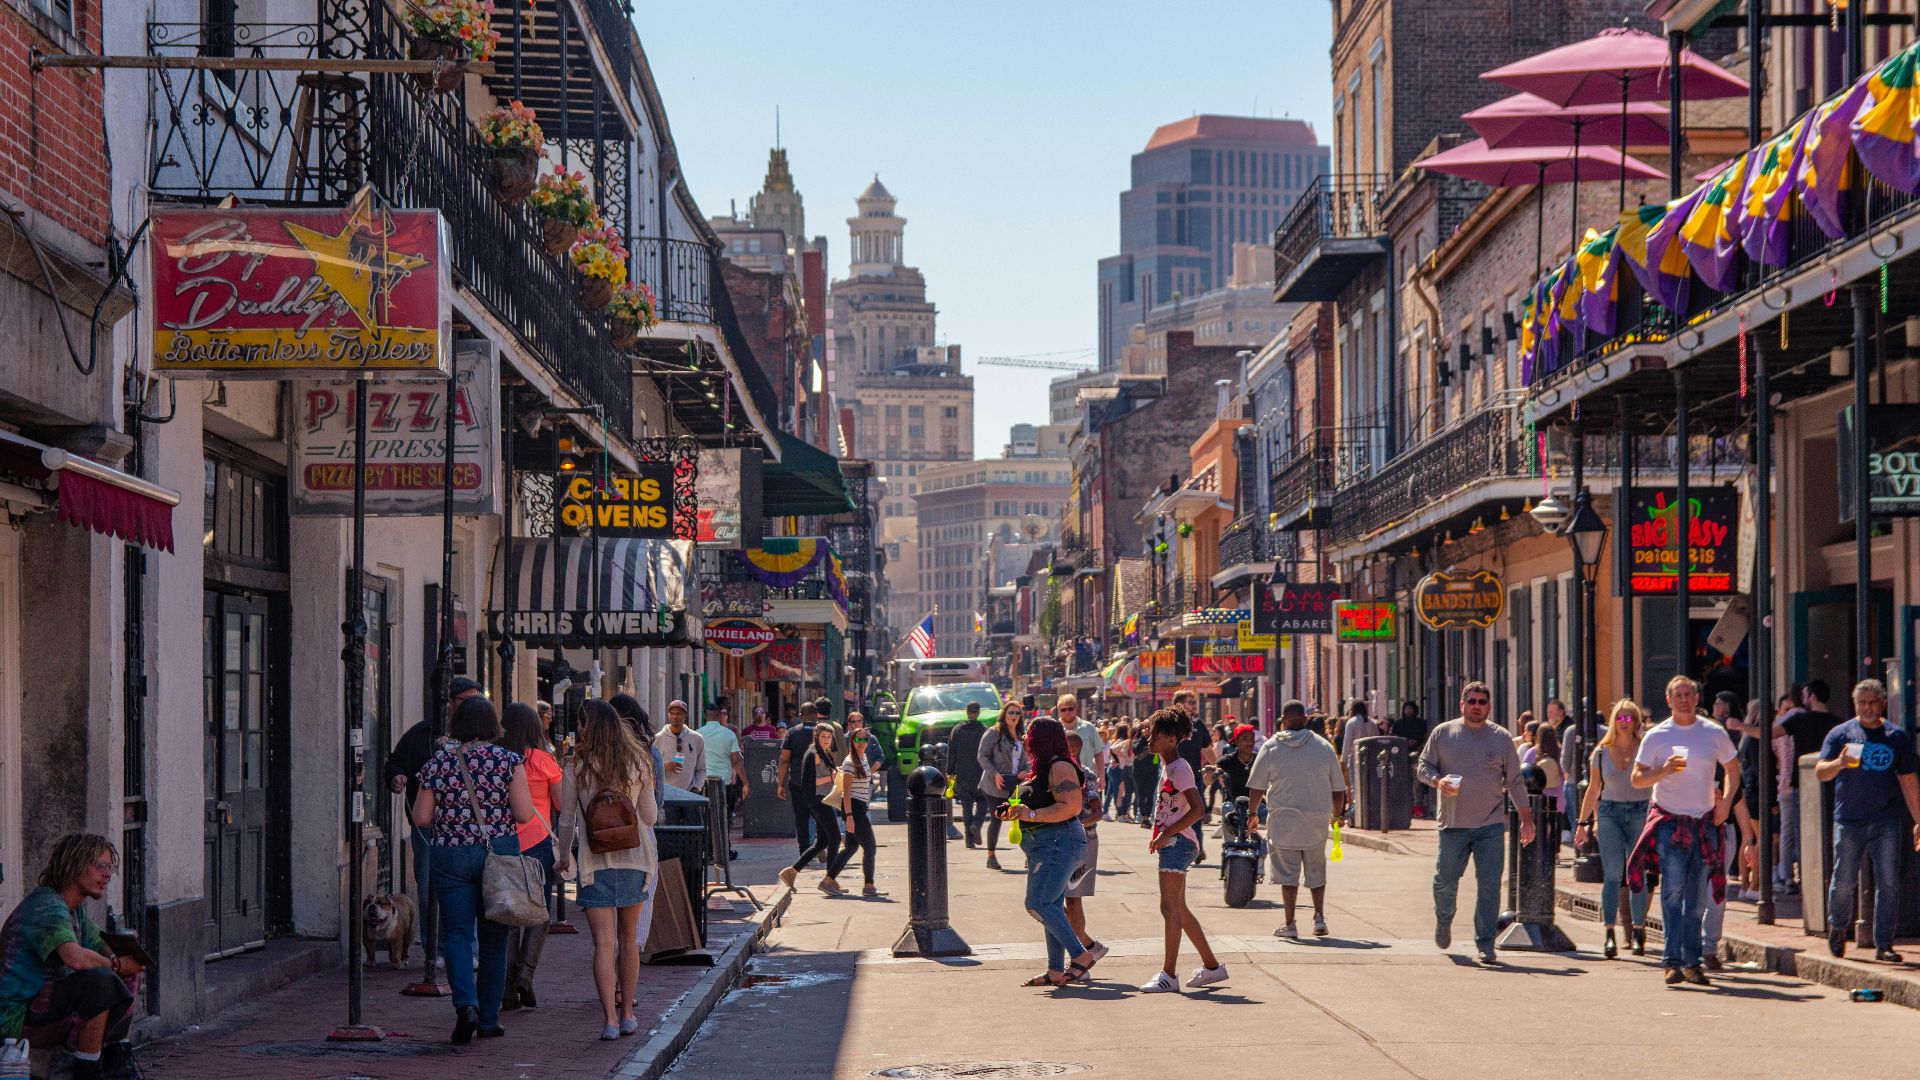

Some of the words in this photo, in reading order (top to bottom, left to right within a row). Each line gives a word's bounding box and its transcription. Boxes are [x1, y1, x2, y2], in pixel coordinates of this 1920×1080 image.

[162, 275, 352, 339] Daddy's
[165, 333, 320, 363] Bottomless
[327, 330, 434, 367] Topless
[305, 386, 481, 434] PIZZA
[335, 438, 447, 459] EPRESS
[365, 465, 385, 488] BY
[390, 465, 423, 488] THE
[428, 465, 476, 488] SLCE
[561, 503, 668, 529] OWENS
[1631, 517, 1668, 547] BIG
[1675, 515, 1728, 547] ASY
[1263, 601, 1326, 612] SUTR
[1424, 593, 1499, 610] BANDSTAND
[496, 612, 573, 635] CHRIS
[584, 612, 675, 634] OWENS
[705, 629, 775, 641] DIXIELAND
[1213, 644, 1241, 653] HUSTLE
[1246, 656, 1265, 672] CLUB
